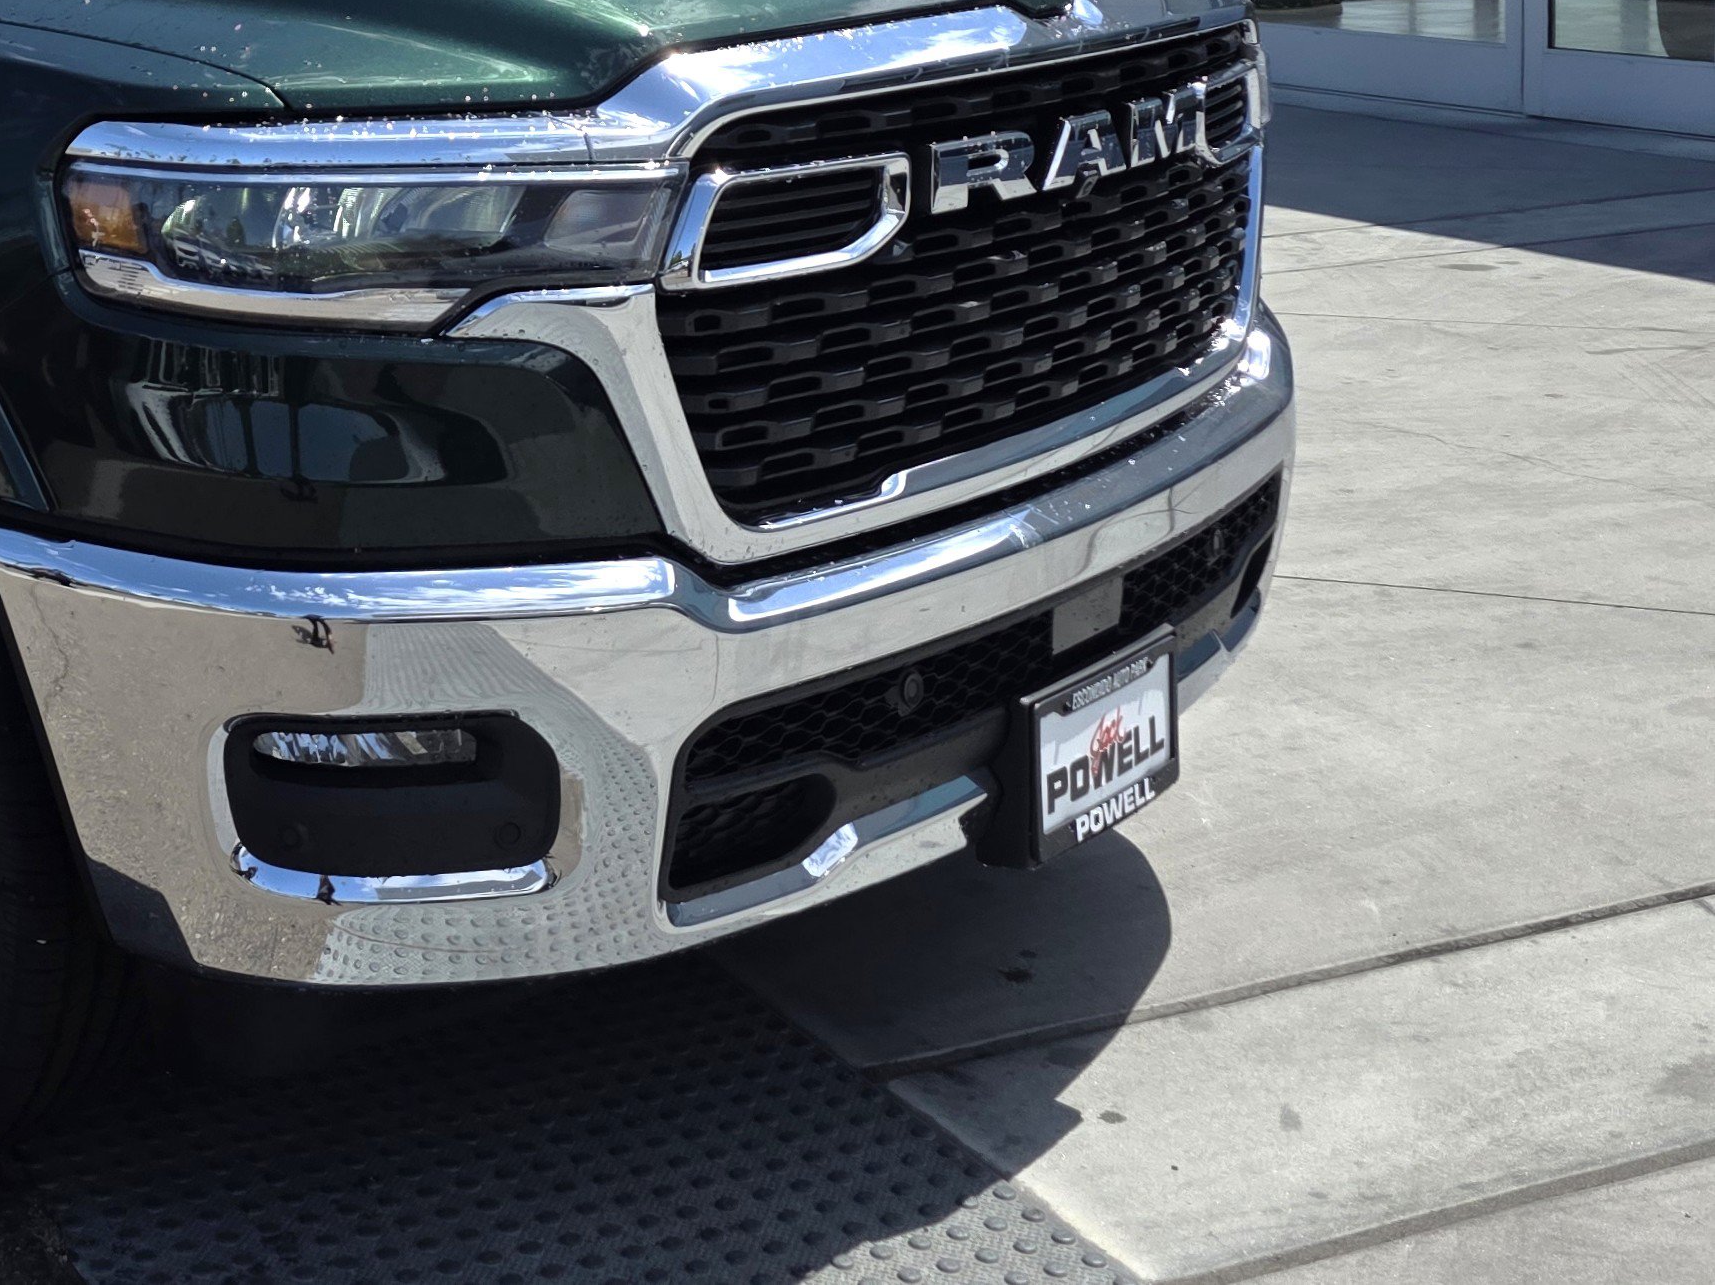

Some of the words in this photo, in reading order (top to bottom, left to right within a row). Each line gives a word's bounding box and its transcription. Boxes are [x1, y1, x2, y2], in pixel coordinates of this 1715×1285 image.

[931, 76, 1206, 214] RAM
[1046, 715, 1165, 815] POWELL
[1075, 776, 1156, 842] POWELL
